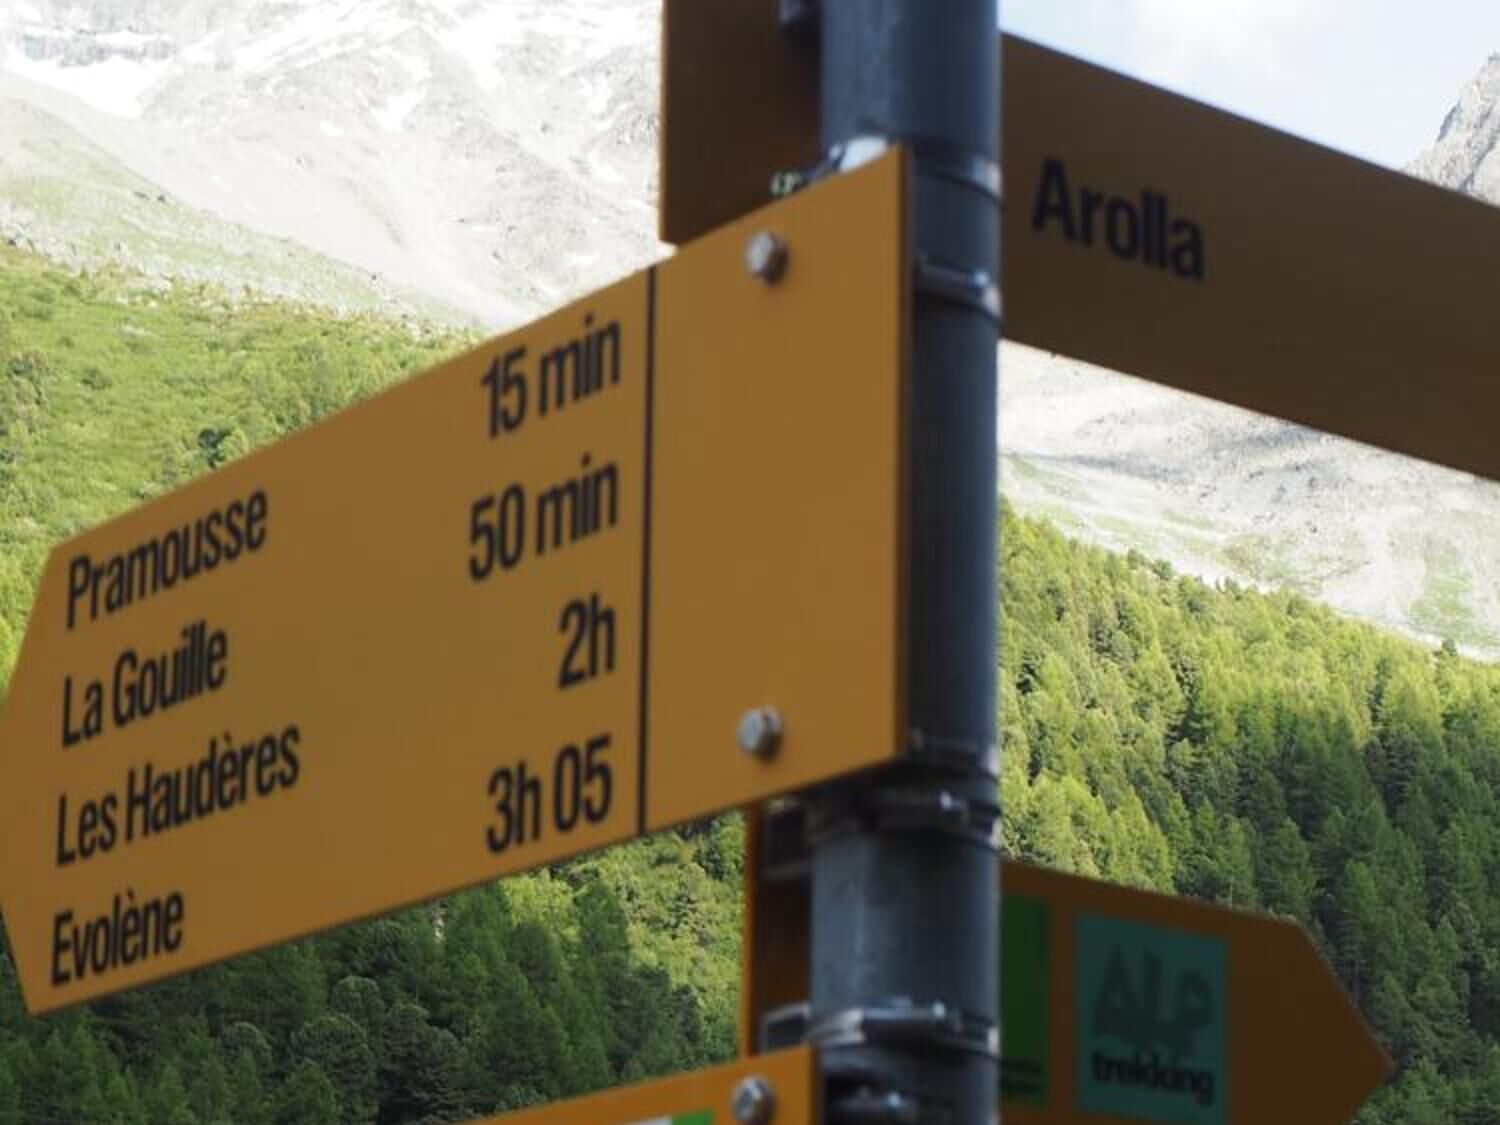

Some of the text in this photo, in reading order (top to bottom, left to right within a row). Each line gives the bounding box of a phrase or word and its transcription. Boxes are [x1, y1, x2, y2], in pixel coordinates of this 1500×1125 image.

[1032, 158, 1206, 283] Arolla
[480, 313, 622, 438] 15 min
[66, 488, 269, 632] Pramousse
[469, 455, 619, 581] 50 min
[61, 620, 229, 749] La Gouille
[557, 593, 616, 689] 2h
[56, 725, 302, 867] Les Haudères
[487, 735, 613, 855] 3h 05
[51, 890, 184, 988] Evolène
[1090, 1051, 1216, 1106] trekking
